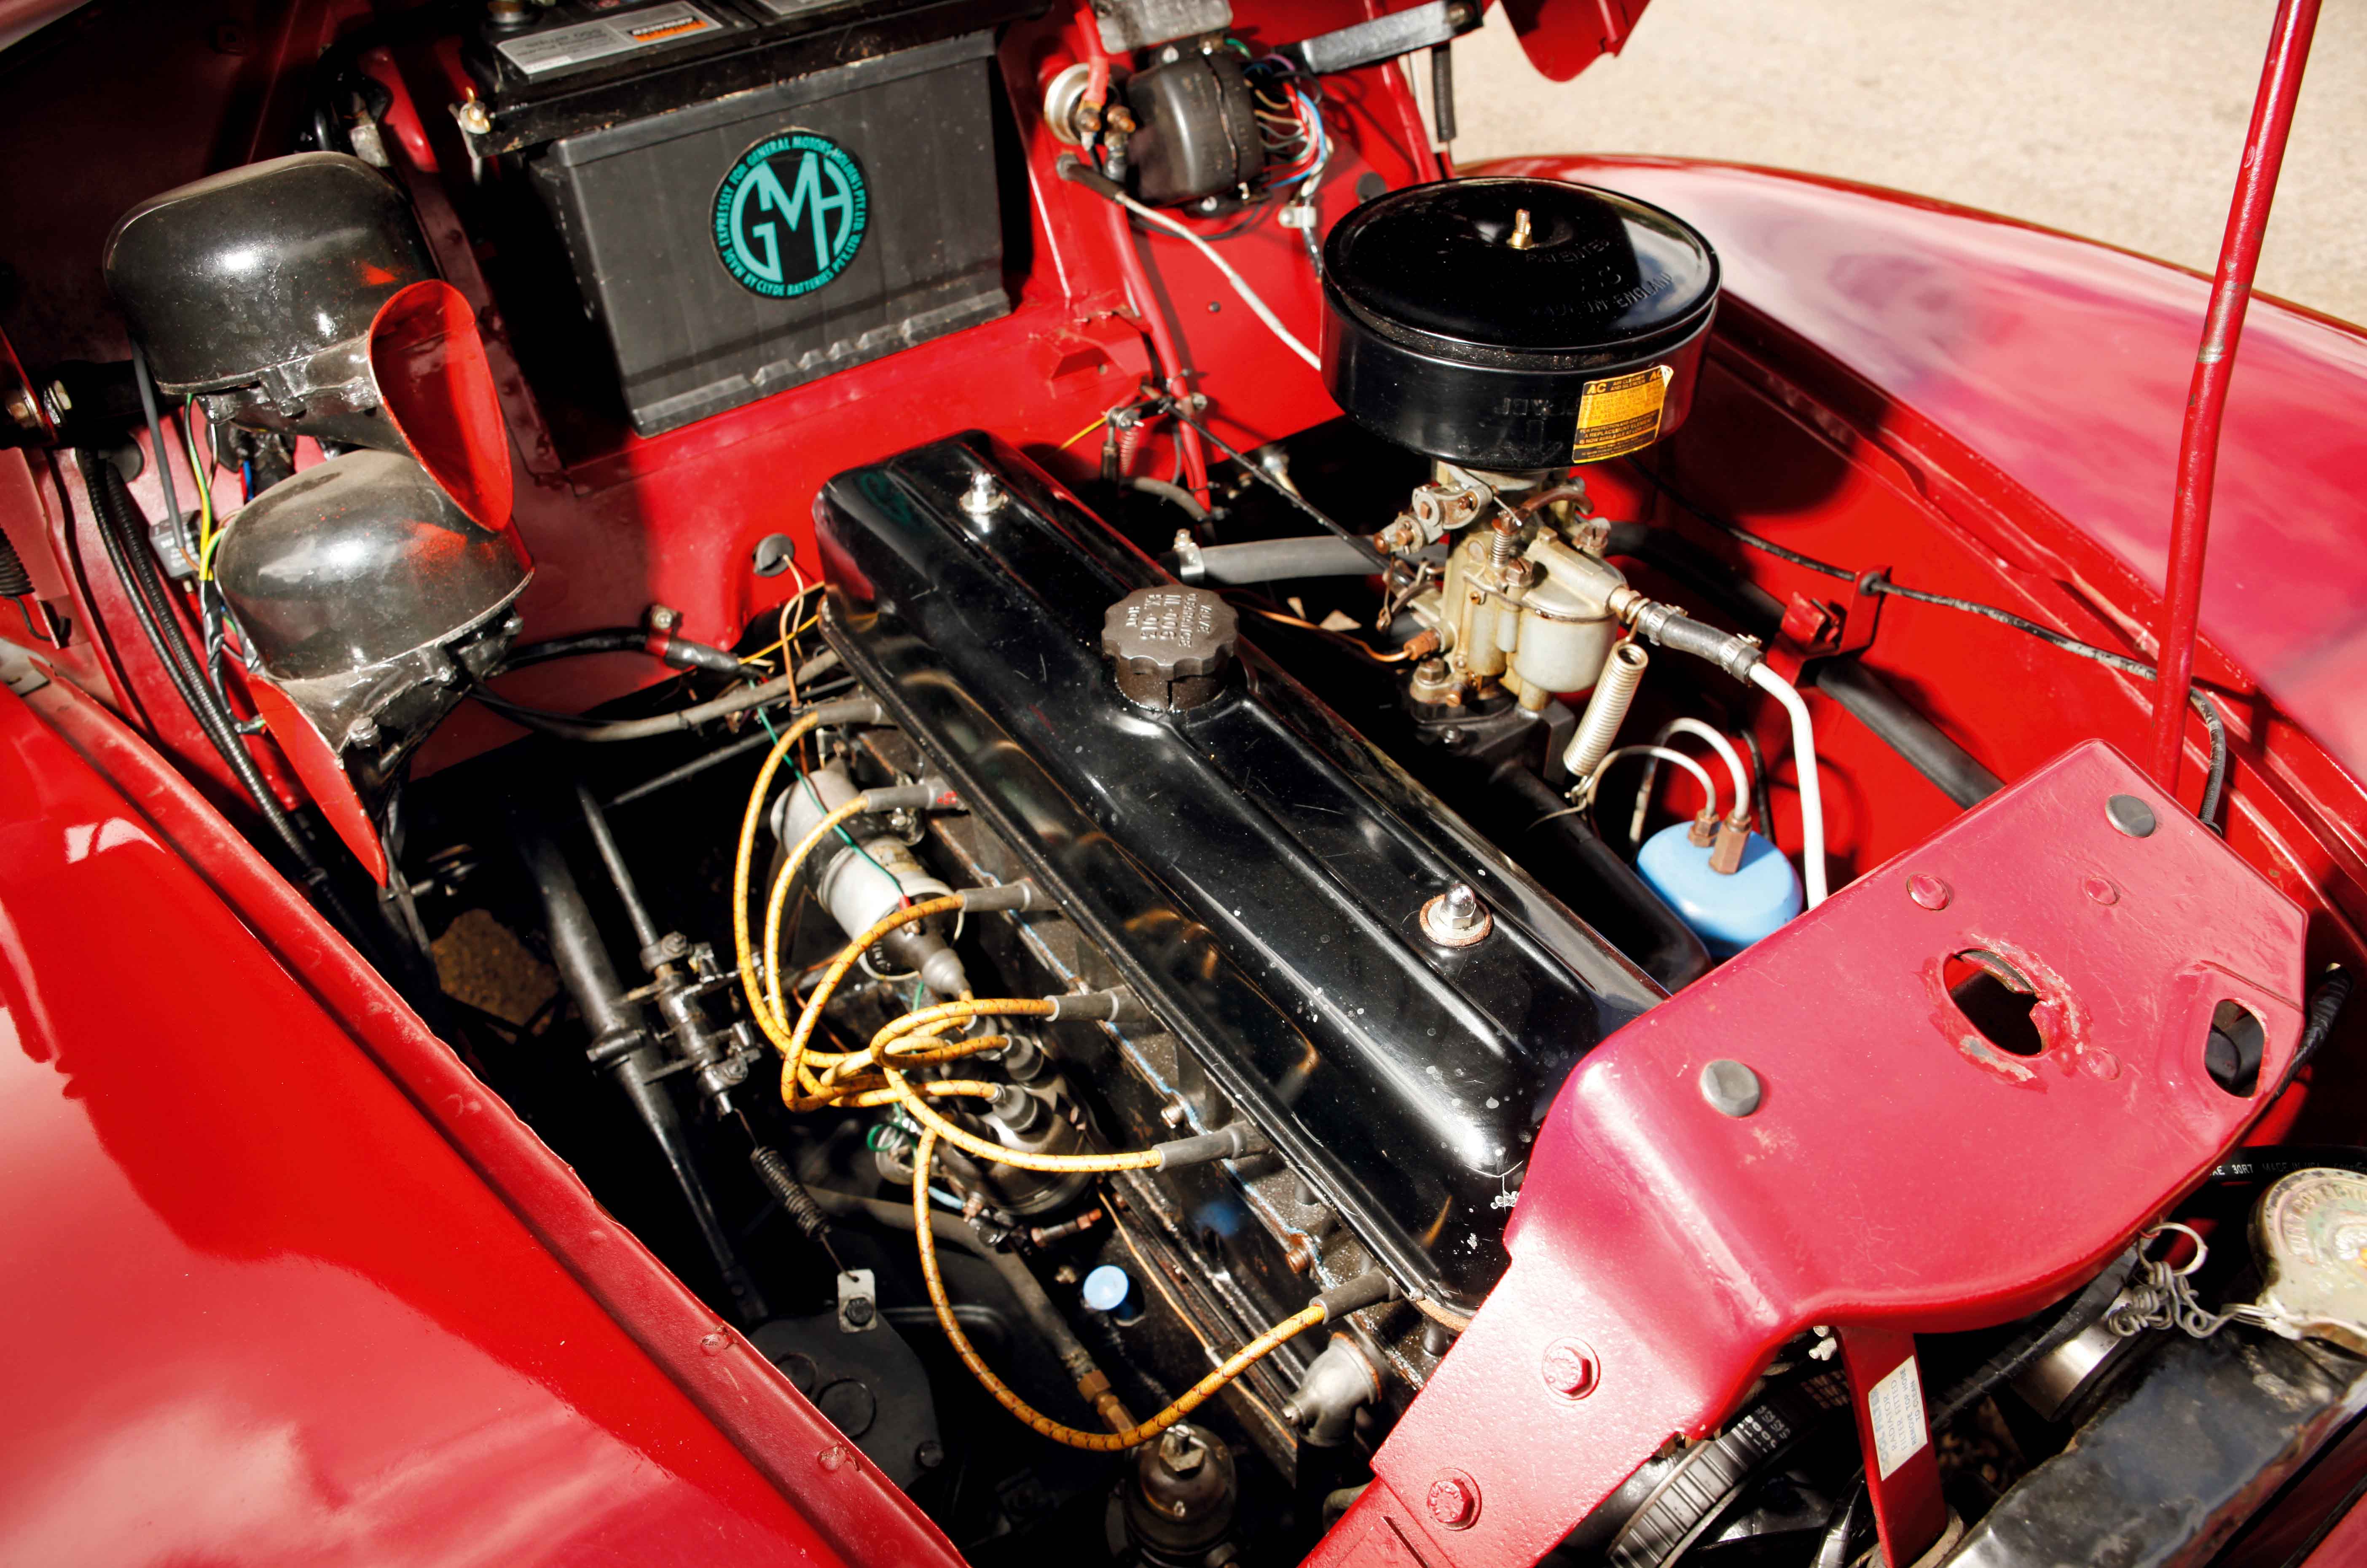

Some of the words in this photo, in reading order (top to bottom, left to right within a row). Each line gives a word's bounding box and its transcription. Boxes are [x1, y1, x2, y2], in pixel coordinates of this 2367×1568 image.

[716, 184, 734, 247] EXPRESSLY
[728, 163, 749, 185] FOR
[746, 137, 791, 166] GENERAL
[743, 273, 759, 288] BY
[756, 280, 785, 296] CLYDE
[786, 269, 835, 296] BATTERIES
[1613, 272, 1672, 308] ENGLAND
[1587, 383, 1607, 395] AC
[1126, 607, 1140, 627] HOT
[1891, 1379, 1902, 1415] FITTED
[1910, 1380, 1919, 1408] CLEAN
[1883, 1393, 1897, 1451] RADIATOR
[1907, 1412, 1917, 1446] REMOVE
[1913, 1409, 1921, 1422] TO
[1897, 1416, 1908, 1451] FILTER
